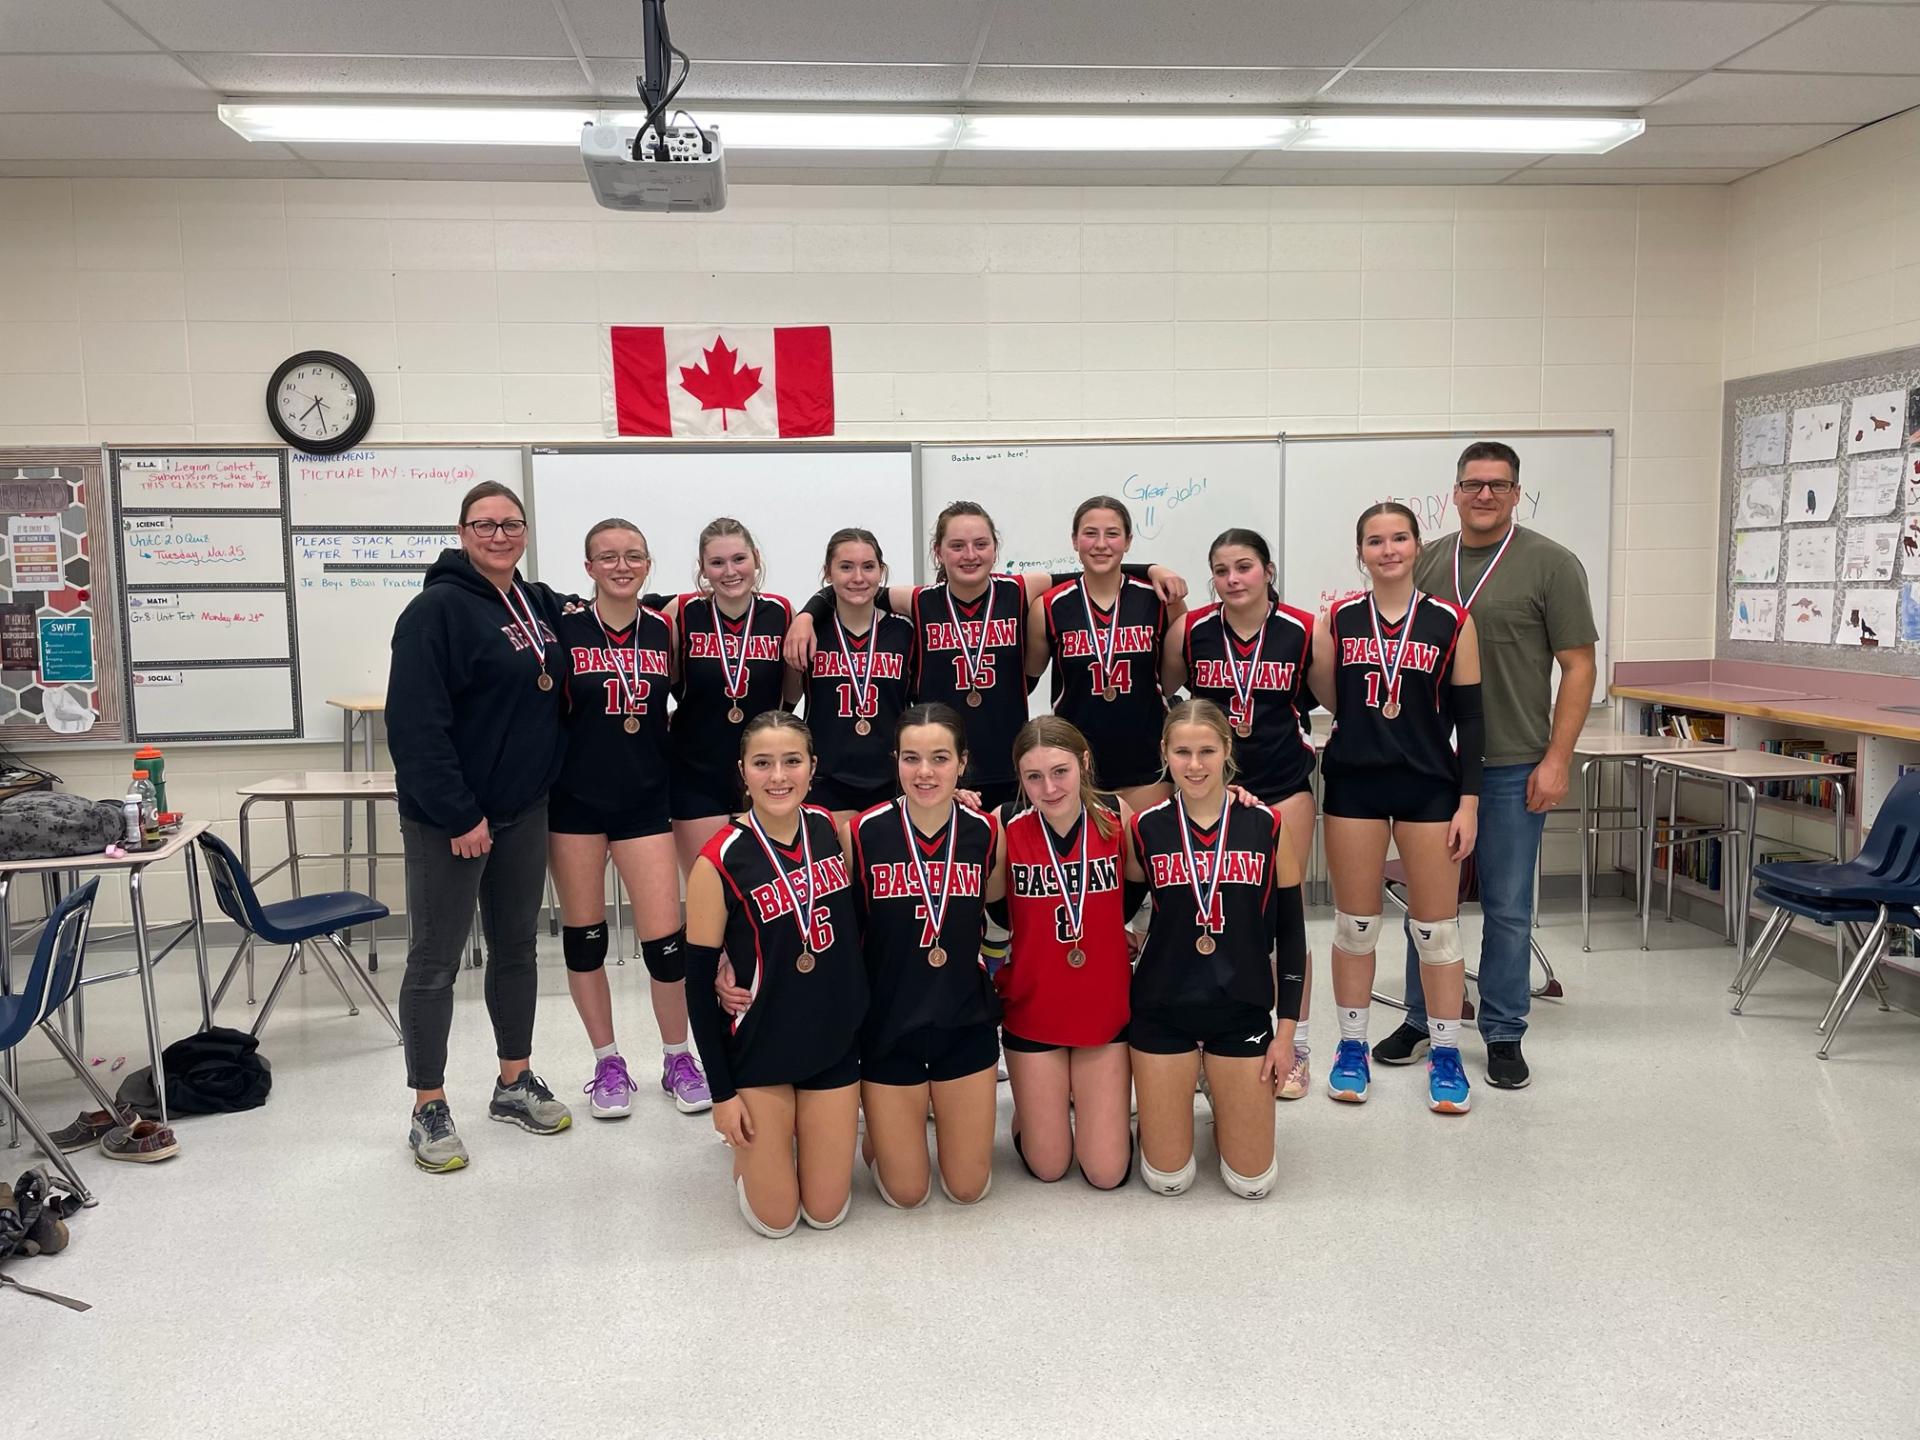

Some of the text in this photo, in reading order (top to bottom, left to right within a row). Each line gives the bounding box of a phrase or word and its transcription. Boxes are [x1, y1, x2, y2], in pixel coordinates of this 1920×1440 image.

[286, 383, 296, 391] 10
[340, 383, 348, 391] 2
[175, 461, 256, 474] Legion Contest
[292, 451, 375, 463] ANNOUNCEMENTS
[149, 472, 218, 482] Submissions
[253, 471, 269, 480] for
[171, 481, 206, 489] CLASS
[300, 467, 365, 480] PICTURE
[136, 520, 165, 528] SCIENCE
[295, 536, 458, 546] PLEASE STACK CHAIRS
[303, 549, 426, 559] AFTER THE LAST
[147, 597, 168, 605] MATH
[51, 623, 76, 632] SWIFT
[177, 611, 196, 621] Test
[926, 618, 1017, 651] BASHAW
[571, 647, 668, 677] BASHAW
[812, 651, 903, 679] BASHAW
[1342, 637, 1439, 673] BASHAW
[952, 654, 996, 690] 15
[1088, 659, 1132, 695] 14
[603, 678, 651, 715] 12
[836, 684, 879, 718] 13
[1228, 695, 1254, 728] 9
[871, 861, 981, 899] BASHAW
[1011, 855, 1119, 897] BASHAW
[915, 905, 942, 948] 7
[1196, 892, 1225, 933] 4
[809, 906, 835, 952] 6
